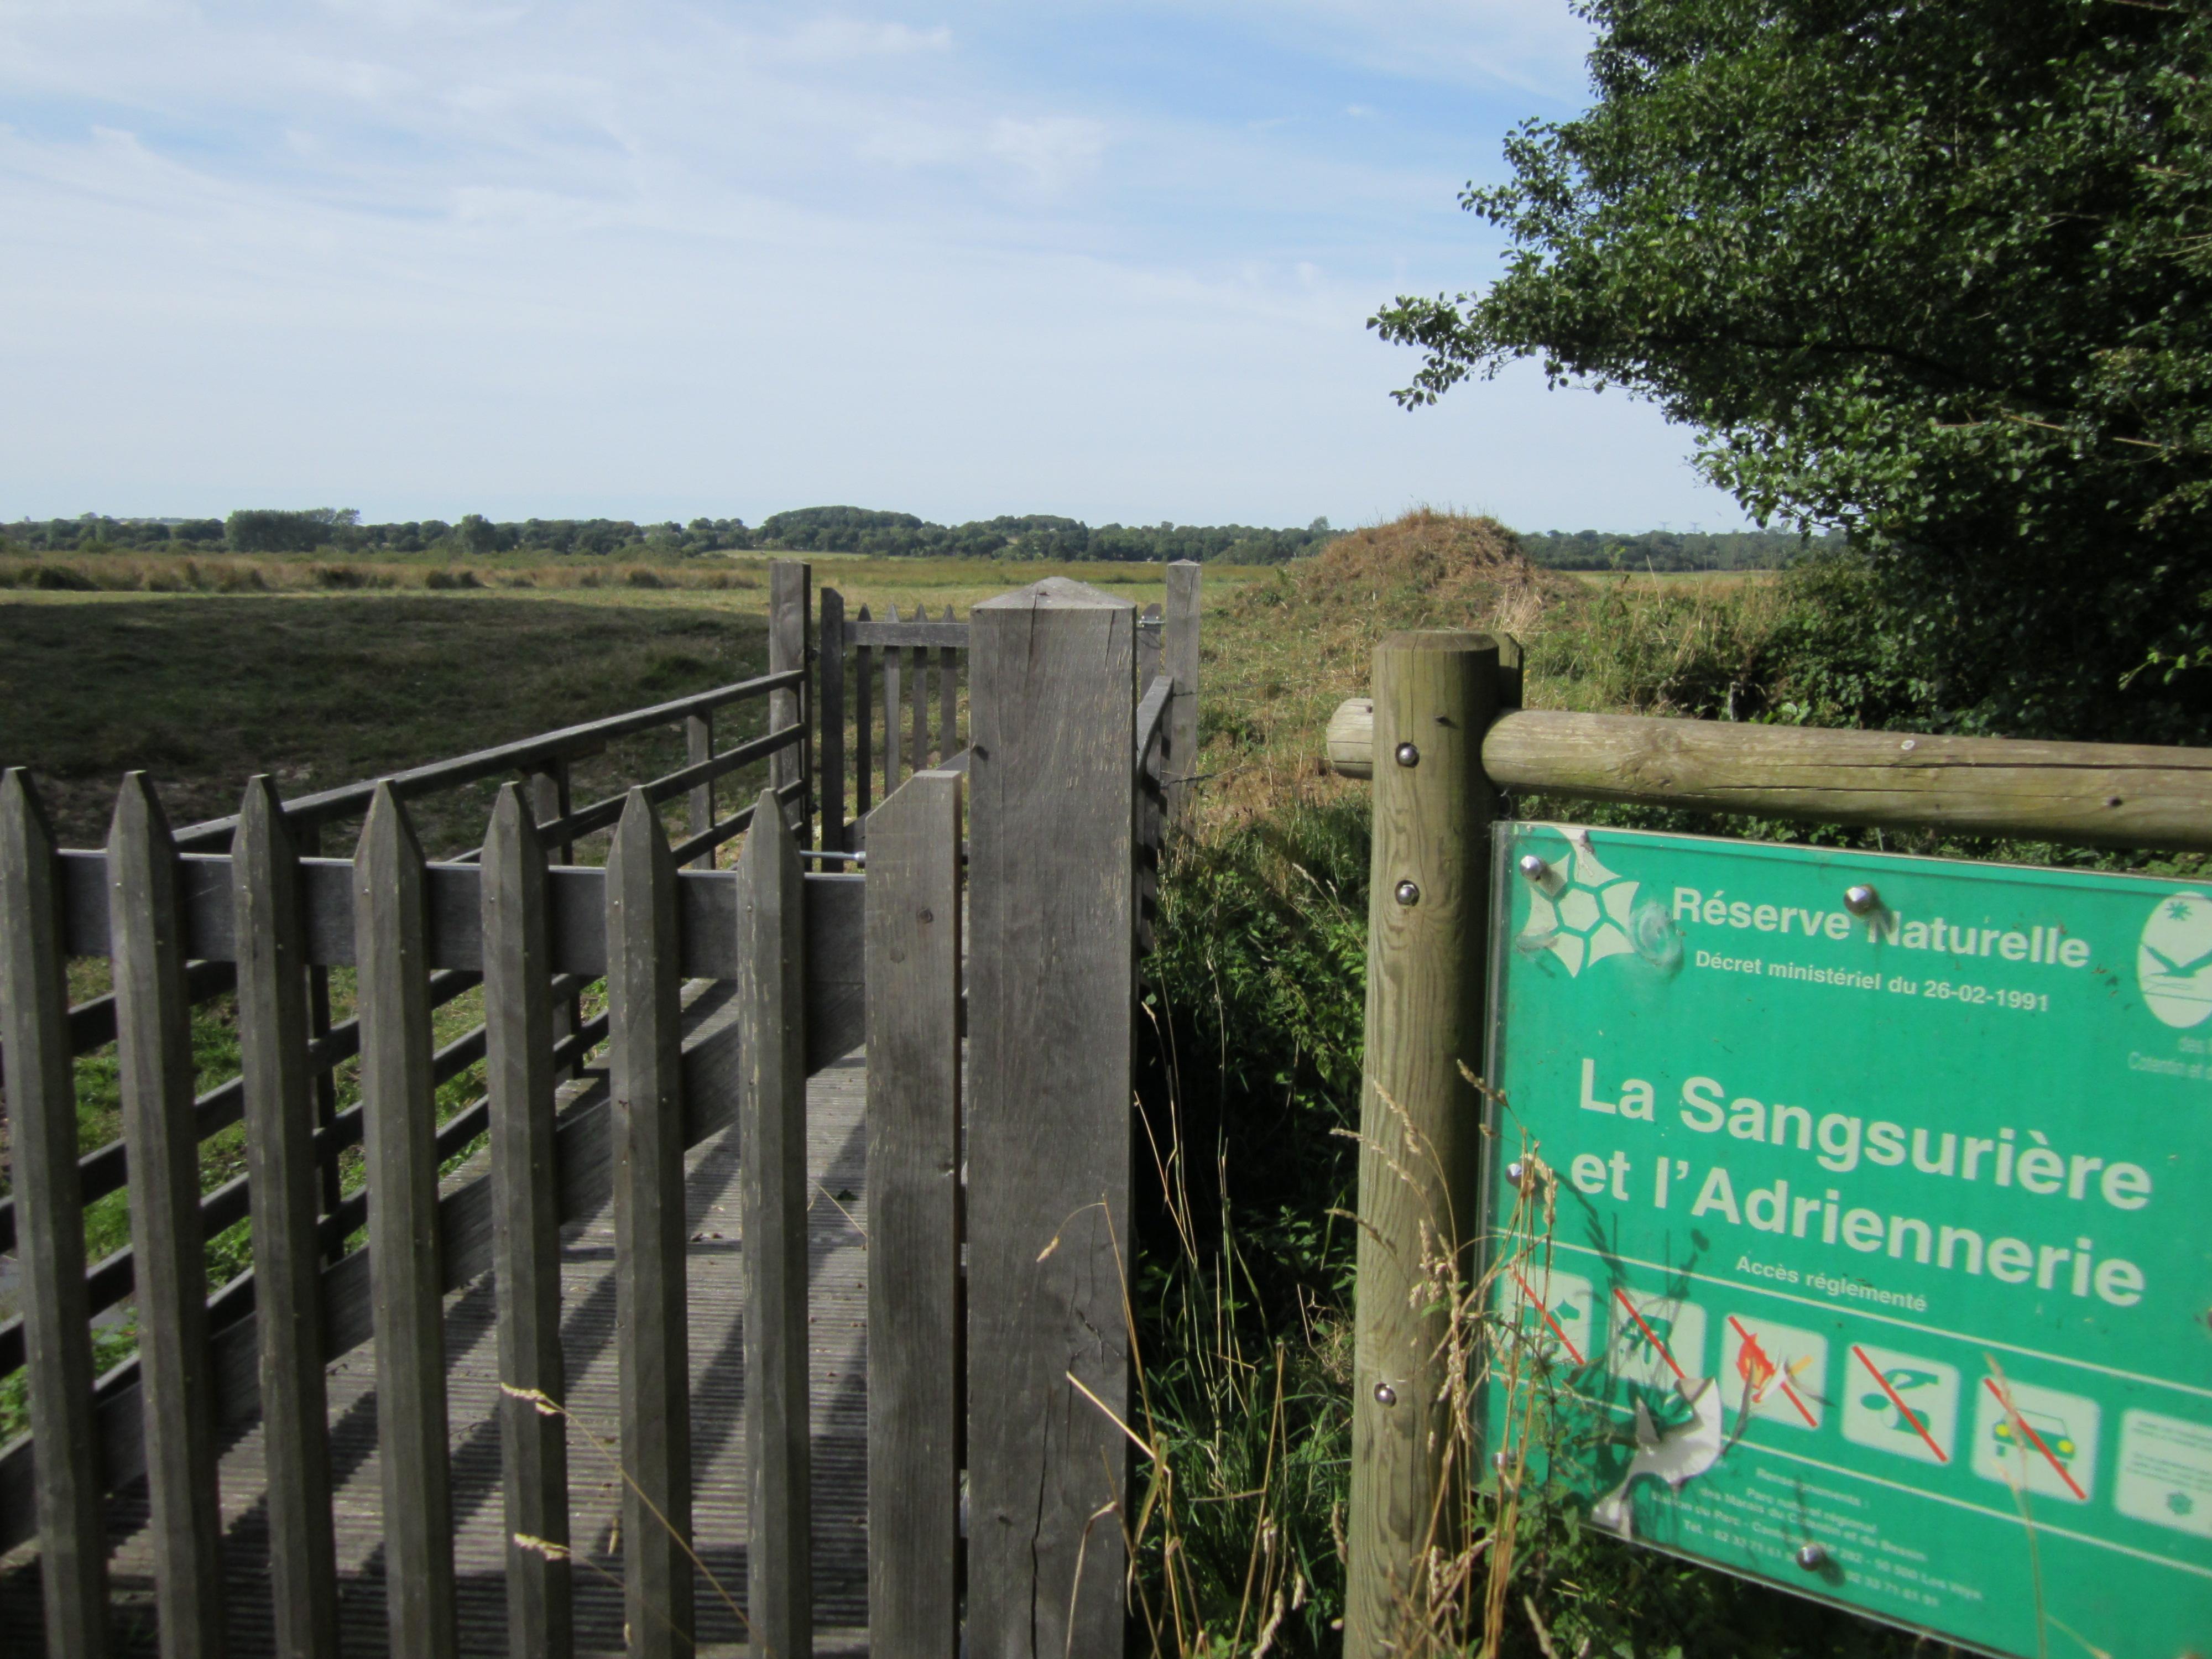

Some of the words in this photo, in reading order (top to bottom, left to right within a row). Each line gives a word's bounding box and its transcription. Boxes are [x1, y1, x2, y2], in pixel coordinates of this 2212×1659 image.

[1673, 887, 1851, 940] Réserve
[1867, 908, 2090, 968] Naturelle
[1695, 950, 1762, 974] Décret
[1770, 962, 1881, 990] ministériel
[1888, 976, 1917, 995] du
[1923, 979, 2049, 1011] 26-02-1991
[1580, 1058, 1654, 1121] La
[1681, 1076, 2153, 1210] Sangsurière
[1571, 1150, 1630, 1201] et
[1655, 1157, 2145, 1307] l'Adriennerie
[1736, 1256, 1799, 1283] Accès
[1806, 1273, 1927, 1312] réglementé
